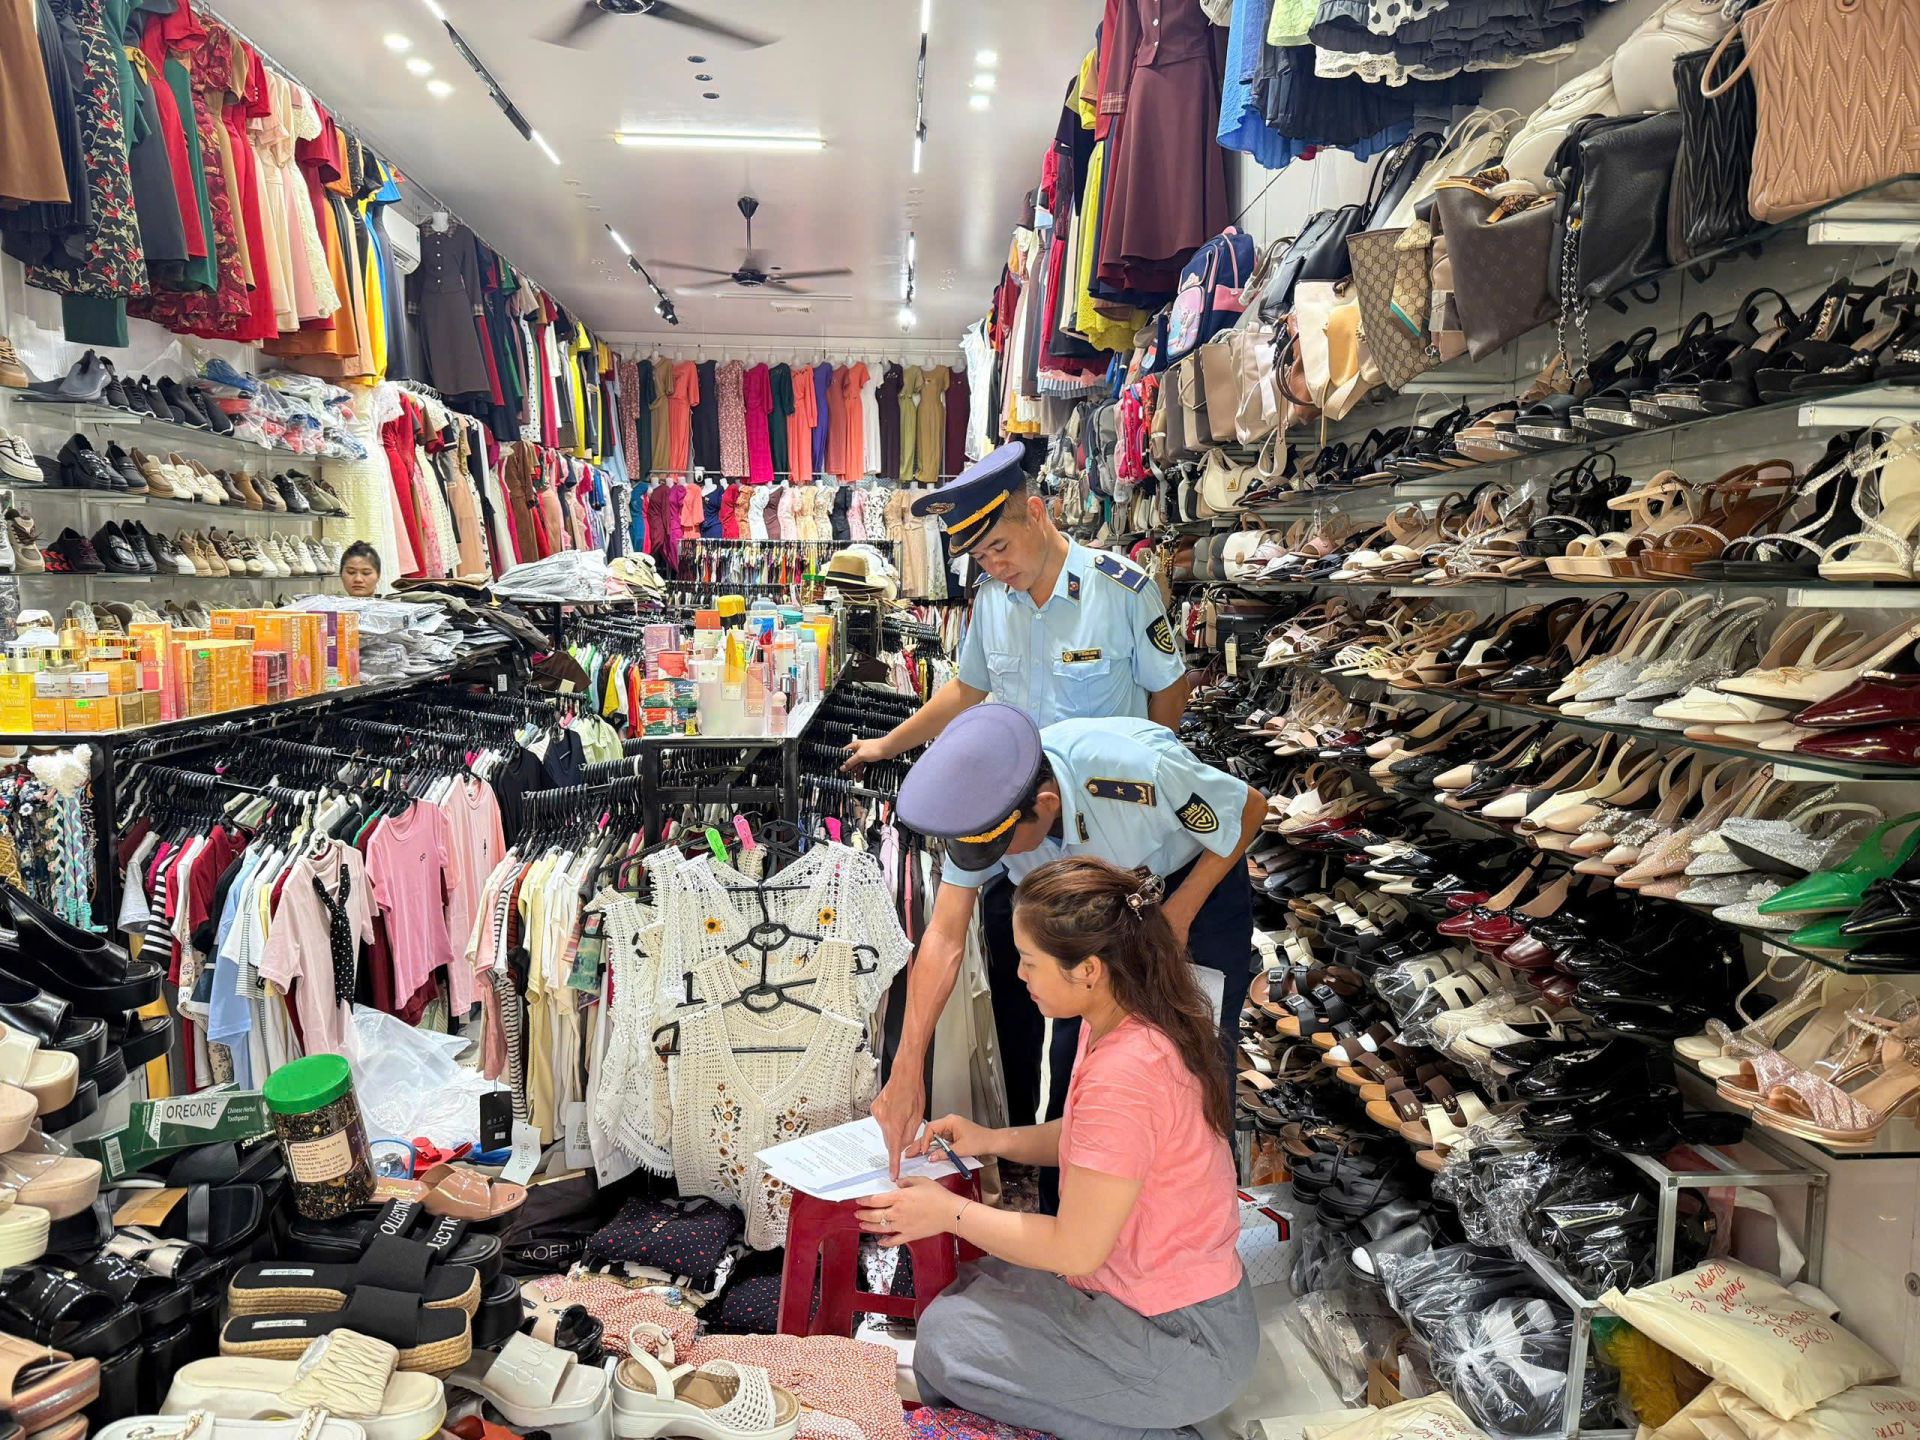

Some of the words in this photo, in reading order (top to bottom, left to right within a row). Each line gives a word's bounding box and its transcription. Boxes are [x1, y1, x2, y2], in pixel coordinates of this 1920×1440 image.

[1180, 802, 1198, 818] DMS
[166, 1102, 217, 1120] ORECARE
[227, 1106, 243, 1114] Chinese
